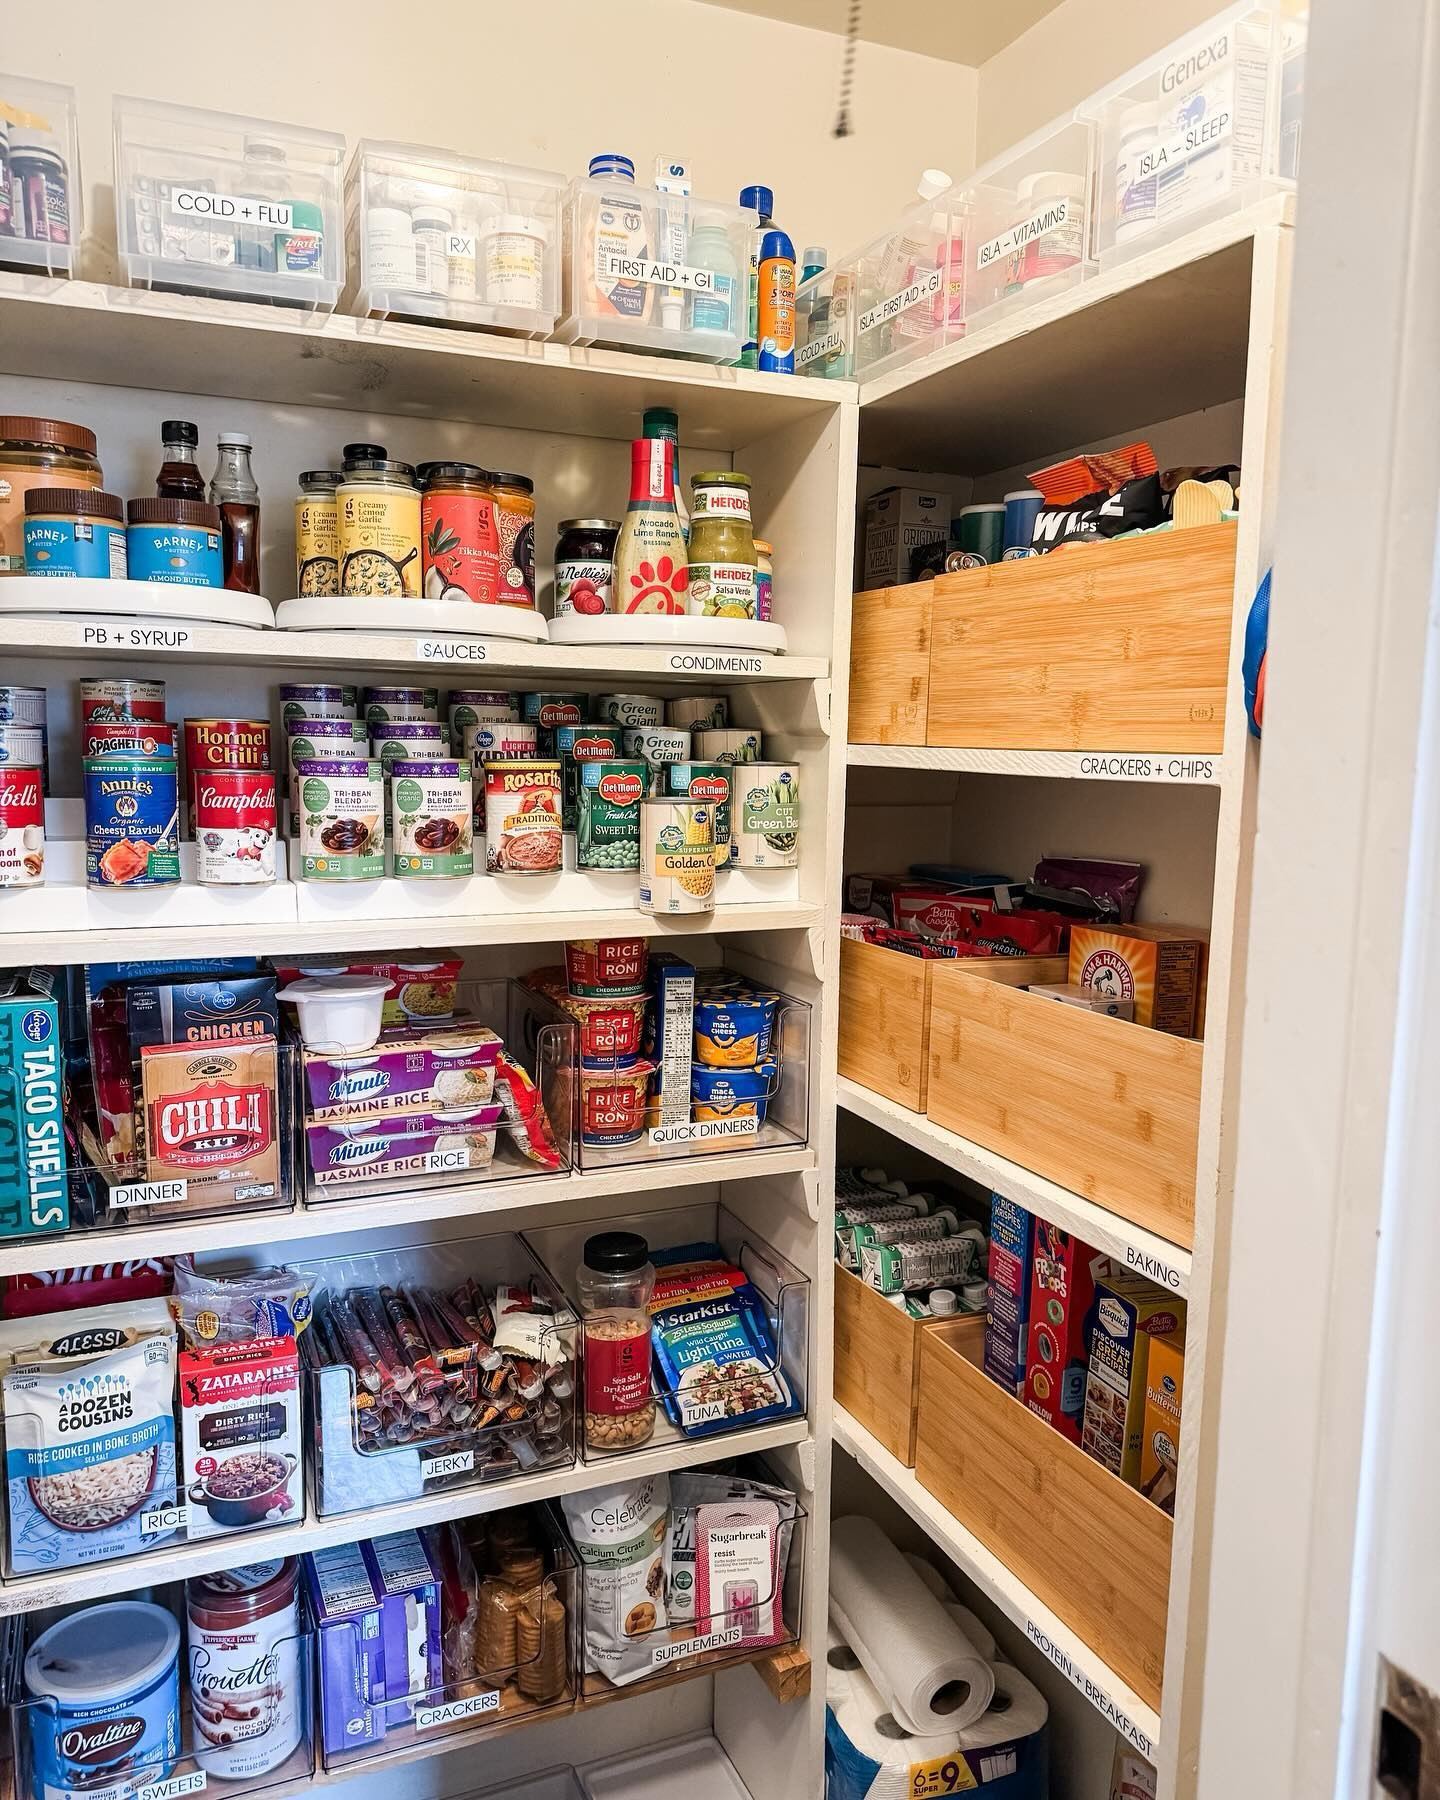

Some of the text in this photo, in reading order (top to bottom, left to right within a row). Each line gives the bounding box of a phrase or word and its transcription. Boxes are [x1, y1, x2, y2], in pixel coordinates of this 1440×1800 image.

[1162, 36, 1228, 93] Genexa
[1140, 114, 1228, 175] ISLA SLEEP
[177, 194, 288, 224] COLD + FLU
[980, 205, 1065, 263] ISLA VITAMINS
[286, 238, 319, 248] ZYRTEC
[451, 237, 470, 254] RX
[598, 245, 627, 255] Antacid
[611, 258, 710, 288] FIRST AID + GI
[860, 312, 875, 330] ISLA
[883, 295, 903, 318] FIRST
[903, 287, 918, 306] AID
[929, 276, 939, 290] GI
[801, 333, 839, 361] COLD + FLU
[359, 502, 388, 510] Creamy
[711, 498, 750, 511] HERDEZ
[640, 519, 673, 528] Avocado
[27, 530, 68, 543] BARNEY
[634, 529, 679, 538] Lime Ranch
[154, 537, 203, 552] BARNEY
[183, 577, 210, 585] BUTTER
[566, 567, 606, 579] Nellie's
[714, 570, 751, 580] HERDEZ
[716, 586, 750, 596] Salsa Verde
[85, 628, 188, 646] PB + SYRUP
[424, 644, 485, 659] SAUCES
[671, 656, 761, 671] CONDIMENTS
[621, 702, 657, 715] Green
[626, 715, 657, 726] Giant
[197, 728, 266, 745] Hormel
[647, 736, 684, 748] Green
[207, 747, 258, 764] Chili
[577, 746, 613, 755] Del Monte
[651, 749, 684, 760] Giant
[1081, 758, 1212, 778] CRACKERS + CHIPS
[100, 777, 153, 795] Annie's
[603, 784, 640, 792] Del Monte
[693, 786, 706, 794] Del
[201, 787, 275, 814] Campbell's
[110, 817, 144, 826] Organic
[605, 810, 638, 820] Fresh Cut
[748, 816, 784, 829] Green
[94, 825, 162, 836] Cheesy Ravioli
[596, 825, 626, 834] SWEET
[665, 856, 705, 868] Golden
[926, 914, 959, 927] Crocker
[931, 906, 955, 921] Betty
[606, 945, 639, 957] RICE
[977, 940, 1026, 957] GHIRARDELLI
[606, 963, 637, 975] RONI
[1084, 954, 1130, 999] ARM & HAMMER
[187, 1020, 265, 1041] CHICKEN
[596, 1034, 628, 1045] RONI
[329, 1071, 390, 1099] Minute
[320, 1092, 430, 1119] JASMINE RICE
[595, 1093, 630, 1105] RICE
[161, 1094, 262, 1145] CHILI
[595, 1111, 629, 1123] RONI
[23, 1045, 63, 1225] TACO SHELLS
[653, 1119, 755, 1142] QUICK DINNERS
[194, 1136, 237, 1150] KIT
[330, 1139, 390, 1164] Minute
[430, 1152, 465, 1168] RICE
[320, 1161, 389, 1183] JASMINE
[116, 1184, 183, 1204] DINNER
[1001, 1199, 1016, 1214] RICE
[995, 1206, 1021, 1229] KRISPIES
[1035, 1258, 1066, 1276] FROOT
[1127, 1247, 1180, 1287] BAKING
[670, 1279, 729, 1297] TUNA FOR TWO
[1038, 1273, 1067, 1298] LOOPS
[669, 1303, 731, 1326] StarKist
[1100, 1304, 1129, 1329] Bisquick
[684, 1319, 731, 1333] Less Sodium
[56, 1330, 121, 1355] ALESSI
[201, 1338, 286, 1357] ZATARAIN'S
[687, 1332, 729, 1347] Wild Caught
[1093, 1328, 1131, 1359] DISCOVER
[678, 1337, 744, 1363] Light Tuna
[724, 1351, 751, 1360] WATER
[1098, 1341, 1130, 1366] GREAT
[1096, 1351, 1129, 1378] RECIPES
[201, 1364, 296, 1392] ZATARAIN'S
[628, 1373, 640, 1382] Salt
[59, 1391, 131, 1416] A DOZEN
[58, 1406, 133, 1432] COUSINS
[215, 1415, 244, 1427] DIRTY
[686, 1407, 721, 1422] TUNA
[28, 1424, 159, 1464] RICE COOKED IN BONE BROTH
[427, 1455, 469, 1475] JERKY
[591, 1490, 652, 1526] Celebrate
[148, 1510, 188, 1529] RICE
[710, 1530, 767, 1543] Sugarbreak
[580, 1539, 645, 1558] Calcium Citrate
[204, 1635, 255, 1644] PEPPERIDGE FARM
[655, 1628, 740, 1662] SUPPLEMENTS
[191, 1644, 278, 1692] Pirouette
[1026, 1619, 1153, 1756] PROTEIN + BREAKFAST
[73, 1702, 126, 1718] RICH CHOCOLATE
[420, 1694, 498, 1725] CRACKERS
[61, 1721, 143, 1758] Ovaltine
[142, 1775, 203, 1800] SWEETS
[914, 1786, 938, 1794] SUPER
